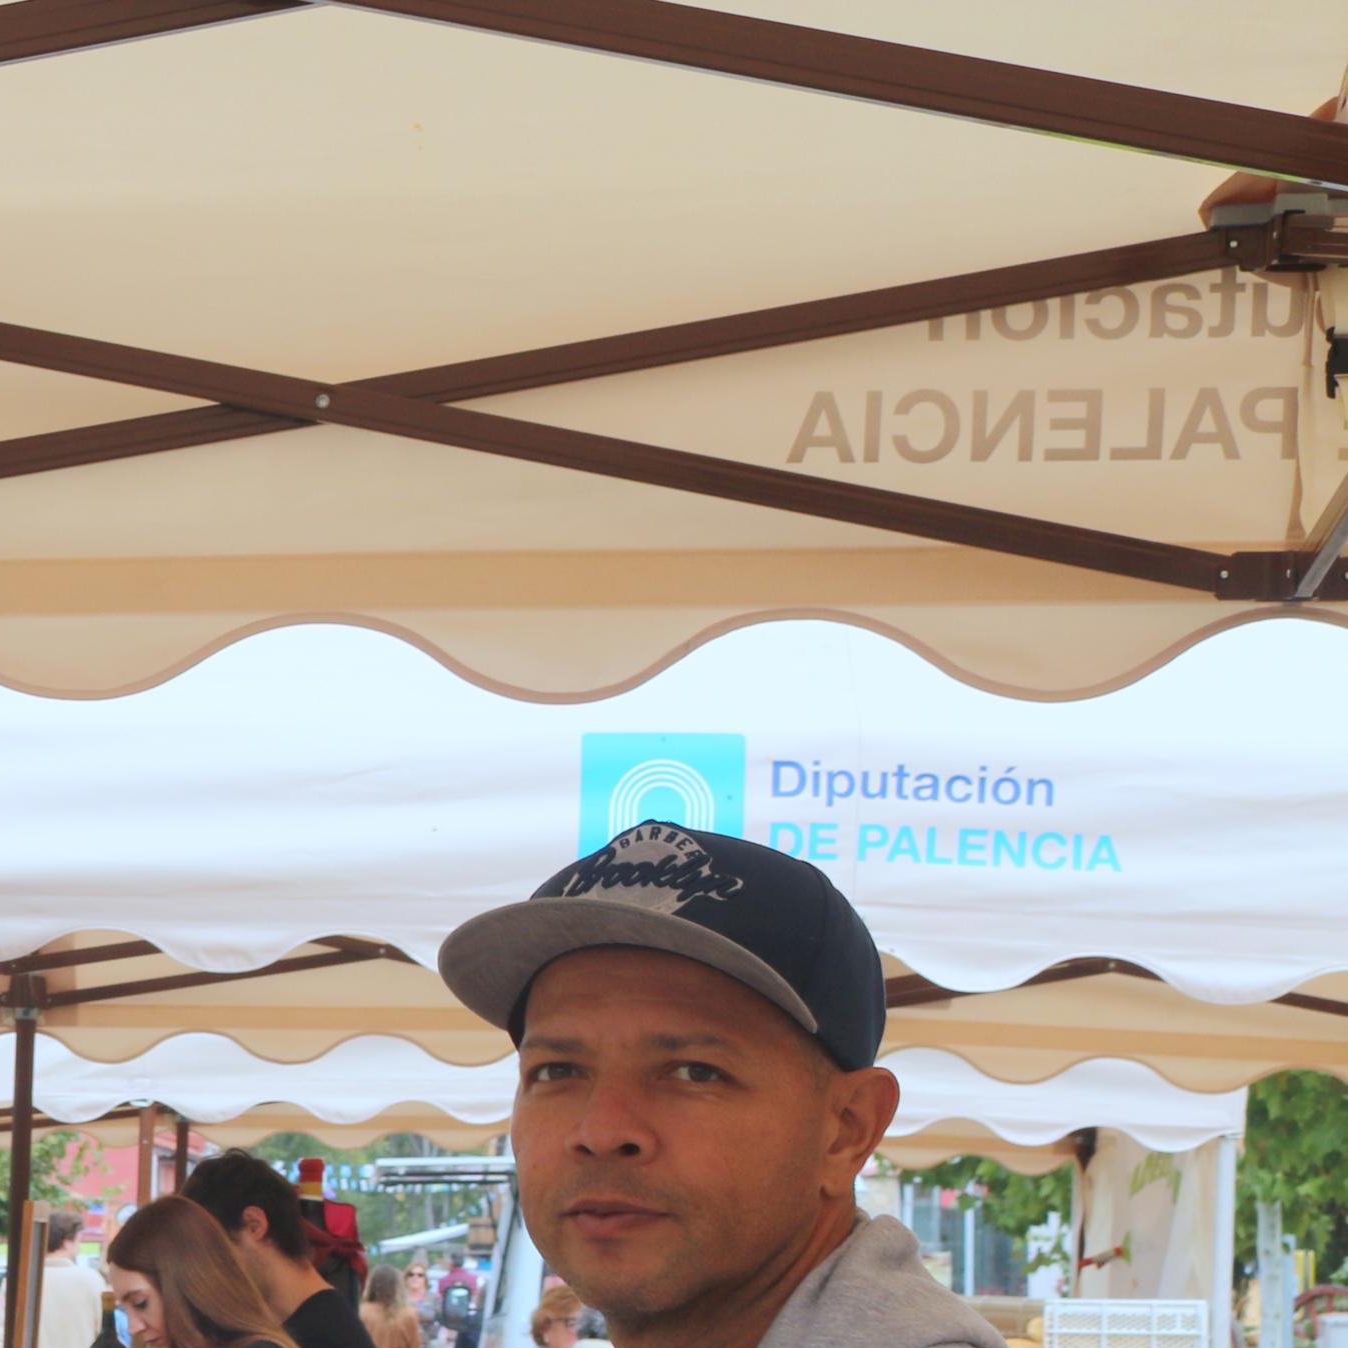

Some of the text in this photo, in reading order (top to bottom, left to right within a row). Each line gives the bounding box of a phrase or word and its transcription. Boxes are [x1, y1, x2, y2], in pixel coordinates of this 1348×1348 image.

[770, 759, 1054, 807] Diputación
[619, 826, 705, 861] BARBER
[769, 823, 1122, 873] DE PALENCIA
